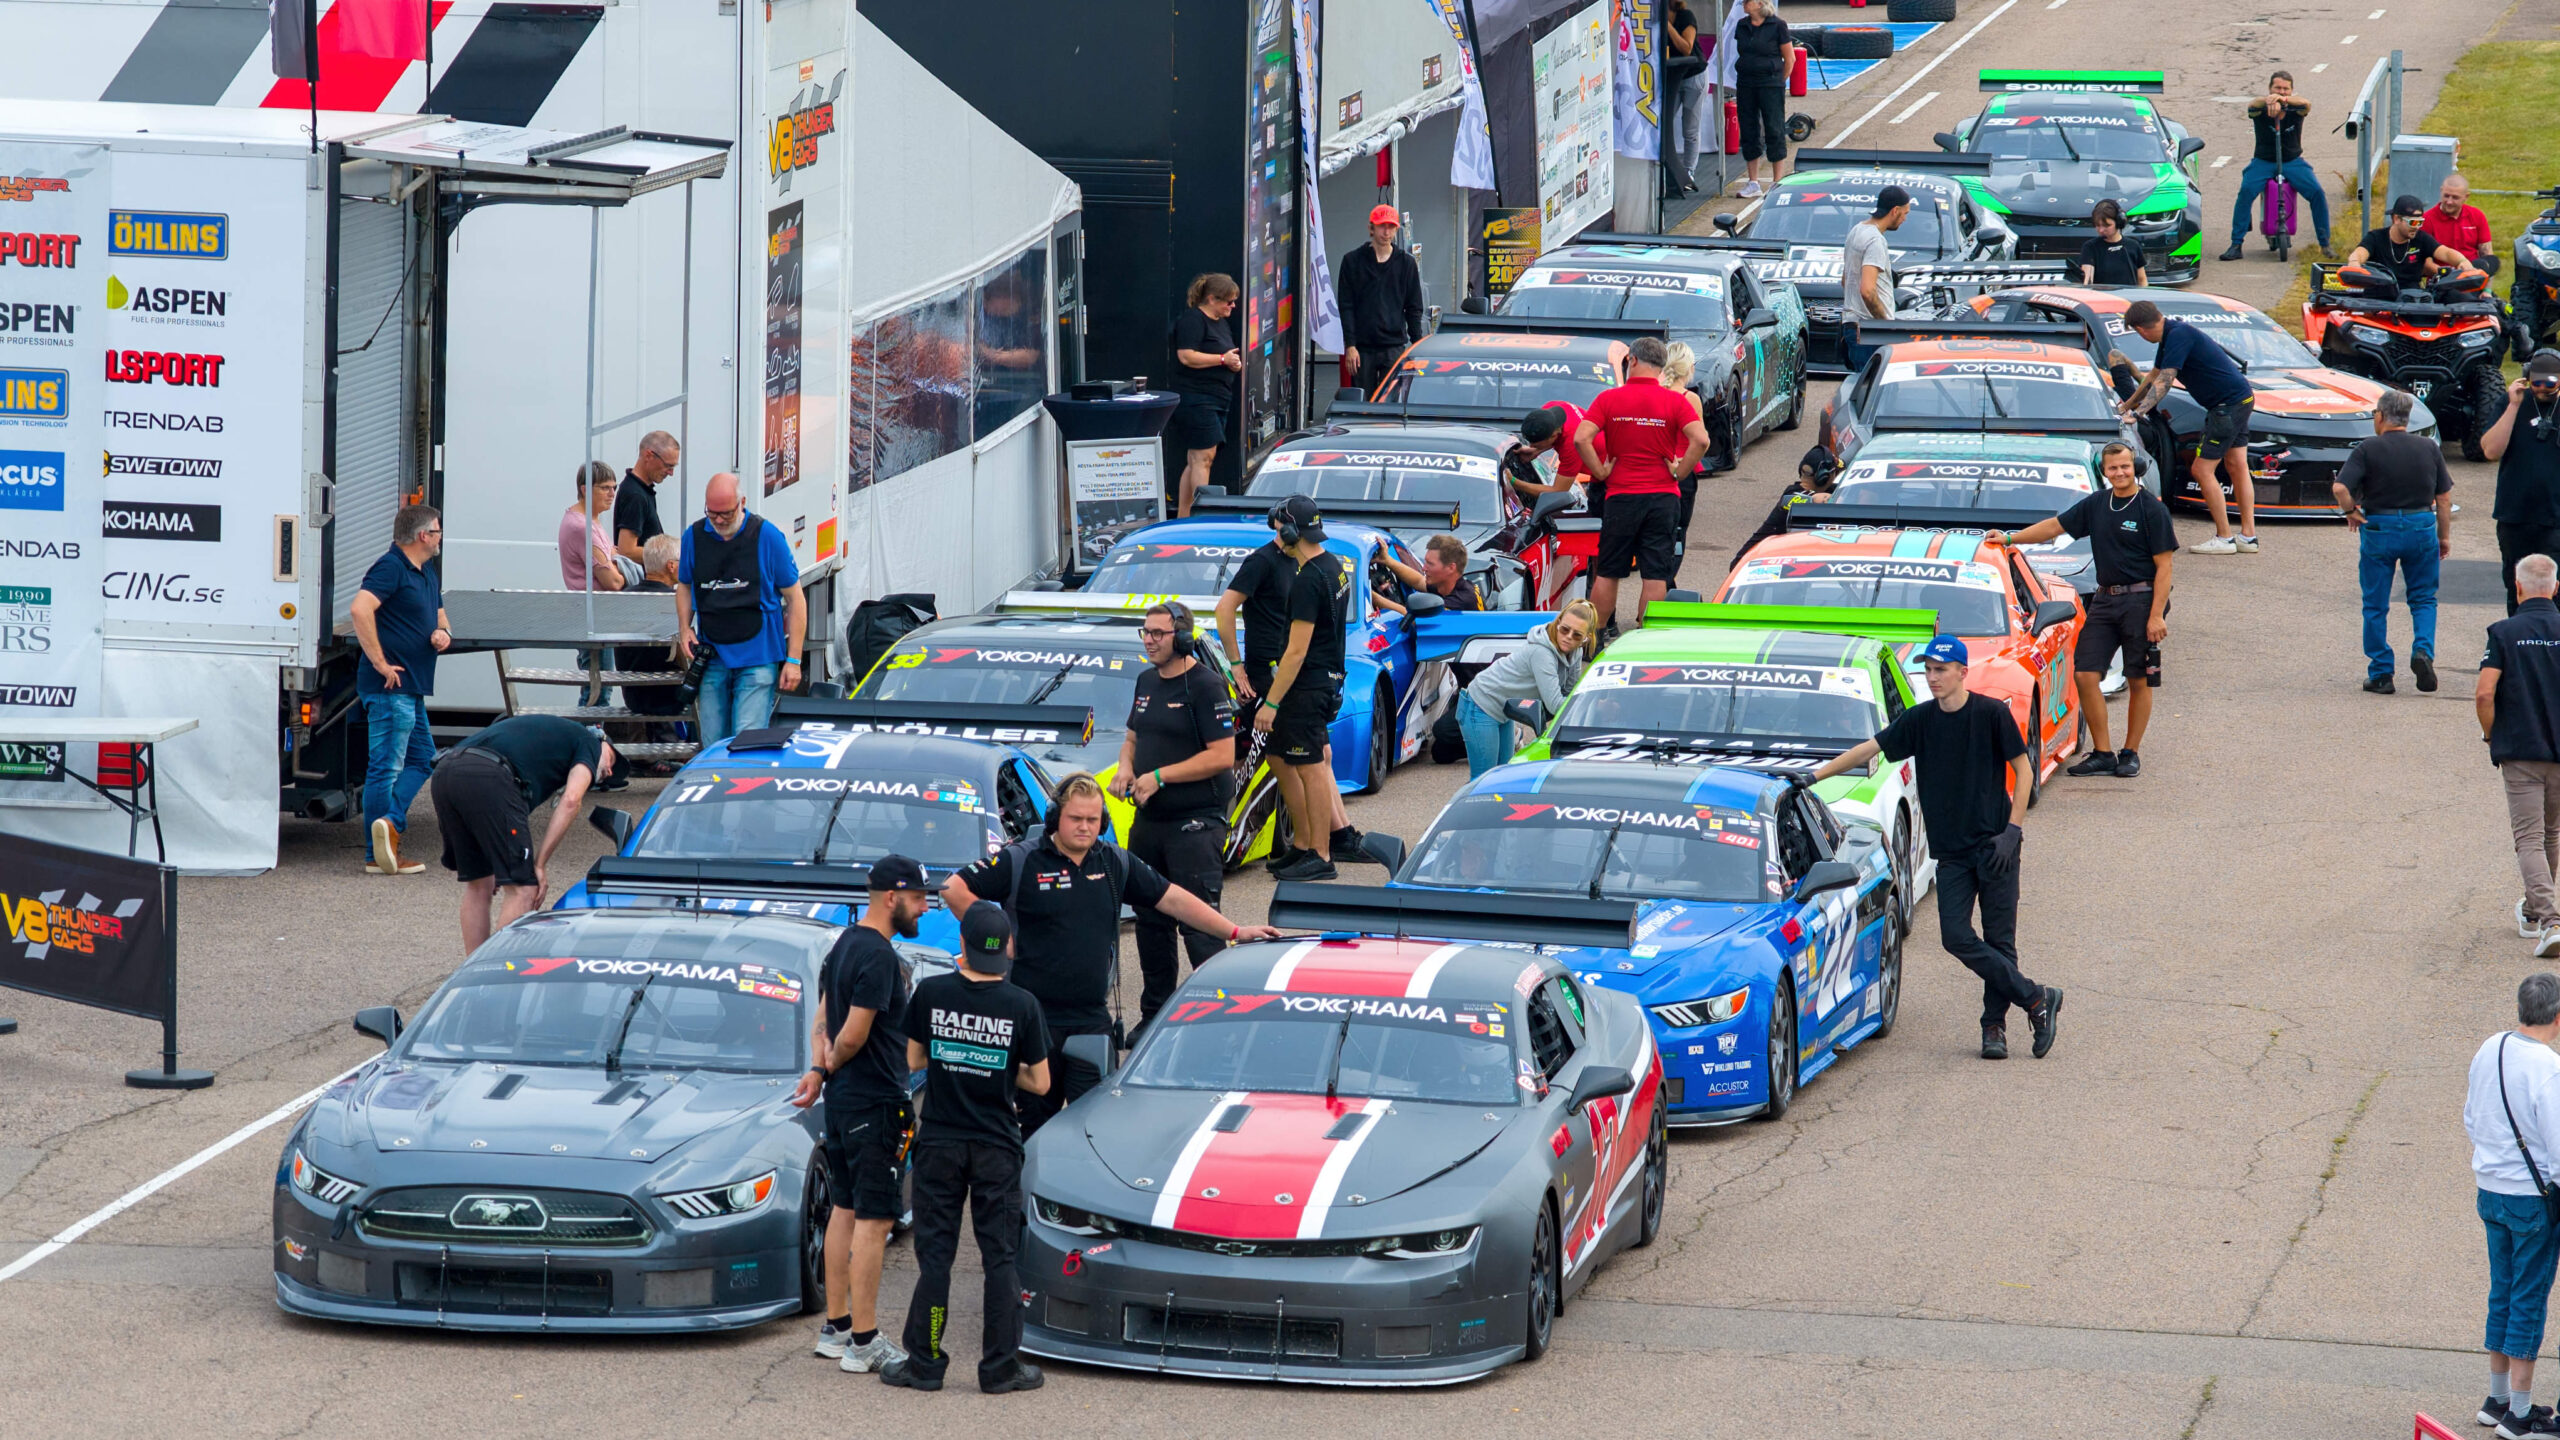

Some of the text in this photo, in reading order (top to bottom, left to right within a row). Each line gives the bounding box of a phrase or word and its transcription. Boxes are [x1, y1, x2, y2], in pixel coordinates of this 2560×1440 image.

[2005, 83, 2140, 92] SOMMEVIE
[794, 103, 835, 139] THUNDER
[2042, 116, 2128, 126] YOKOHAMA
[769, 115, 793, 178] V8
[794, 137, 818, 170] CARS
[1840, 176, 1947, 194] Försäkring
[1829, 194, 1919, 206] YOKOHA
[114, 214, 219, 252] ÖHLINS
[1483, 218, 1510, 238] V8
[1586, 274, 1681, 288] YOKOHAMA
[132, 287, 226, 316] ASPEN
[131, 315, 225, 328] FUEL FOR PROFESSIONALS
[7, 336, 74, 347] PROFESSIONALS
[1468, 361, 1572, 374] YOKOHAMA
[1953, 363, 2059, 377] YOKOHAMA
[22, 420, 68, 429] TECHNOLOGY
[110, 456, 222, 477] SWETOWN
[1345, 454, 1456, 469] YOKOHAMA
[0, 465, 57, 487] CUS
[1848, 465, 2041, 480] 70 YOKOHAMA
[1828, 564, 1952, 579] YOKOHAMA
[8, 590, 44, 601] 1990
[2, 624, 51, 651] RS
[887, 649, 1104, 669] 33 YOKOHAMA
[1594, 664, 1813, 686] 19 YOKOHAMA
[675, 785, 714, 803] 11
[775, 777, 919, 798] YOKOHAMA
[1554, 806, 1700, 830] YOKOHAMA
[1726, 834, 1756, 846] 401
[0, 892, 123, 944] V8 THUNDER
[51, 930, 95, 954] CARS
[576, 959, 738, 983] YOKOHAMA
[1168, 1001, 1225, 1022] 17
[1281, 996, 1448, 1023] YOKOHAMA
[931, 1008, 1013, 1035] RACING
[930, 1024, 1012, 1046] TECHNICIAN
[1709, 1080, 1749, 1093] ACCUSTOR
